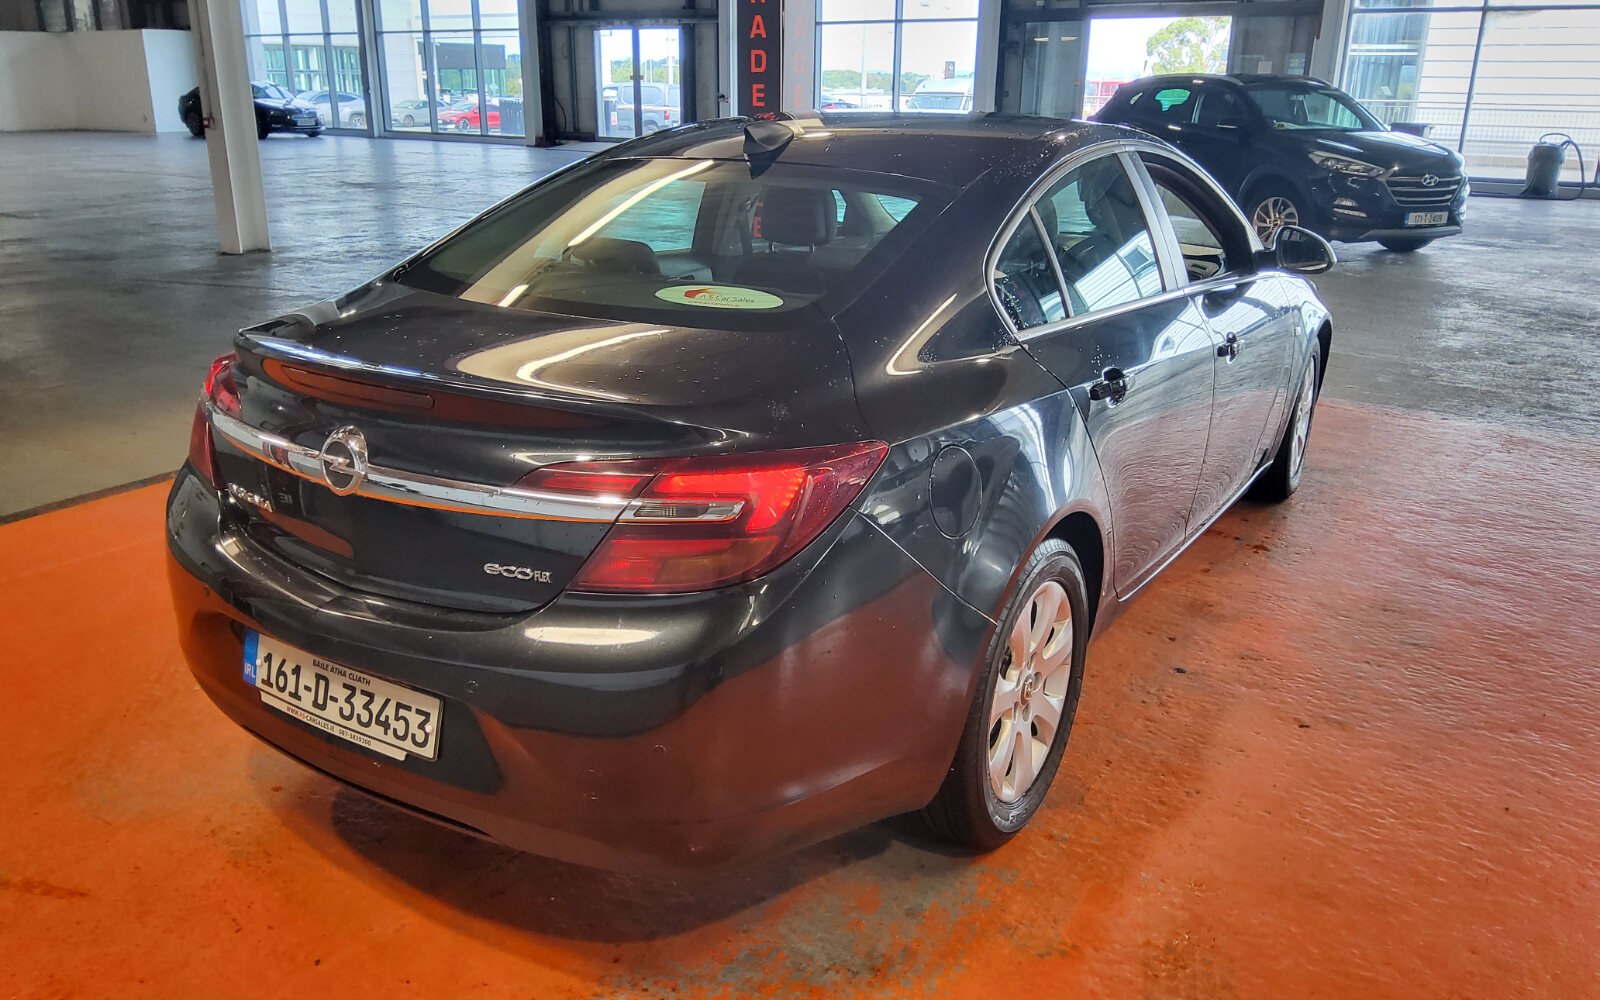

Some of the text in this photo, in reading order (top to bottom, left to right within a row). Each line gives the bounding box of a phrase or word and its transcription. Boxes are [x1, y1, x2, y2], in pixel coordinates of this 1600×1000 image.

[750, 0, 767, 107] ADE
[732, 296, 755, 304] Sales
[244, 662, 256, 679] IRL
[312, 659, 329, 672] BAILE
[348, 672, 371, 687] CLIATH
[261, 652, 431, 748] 161-D-33453
